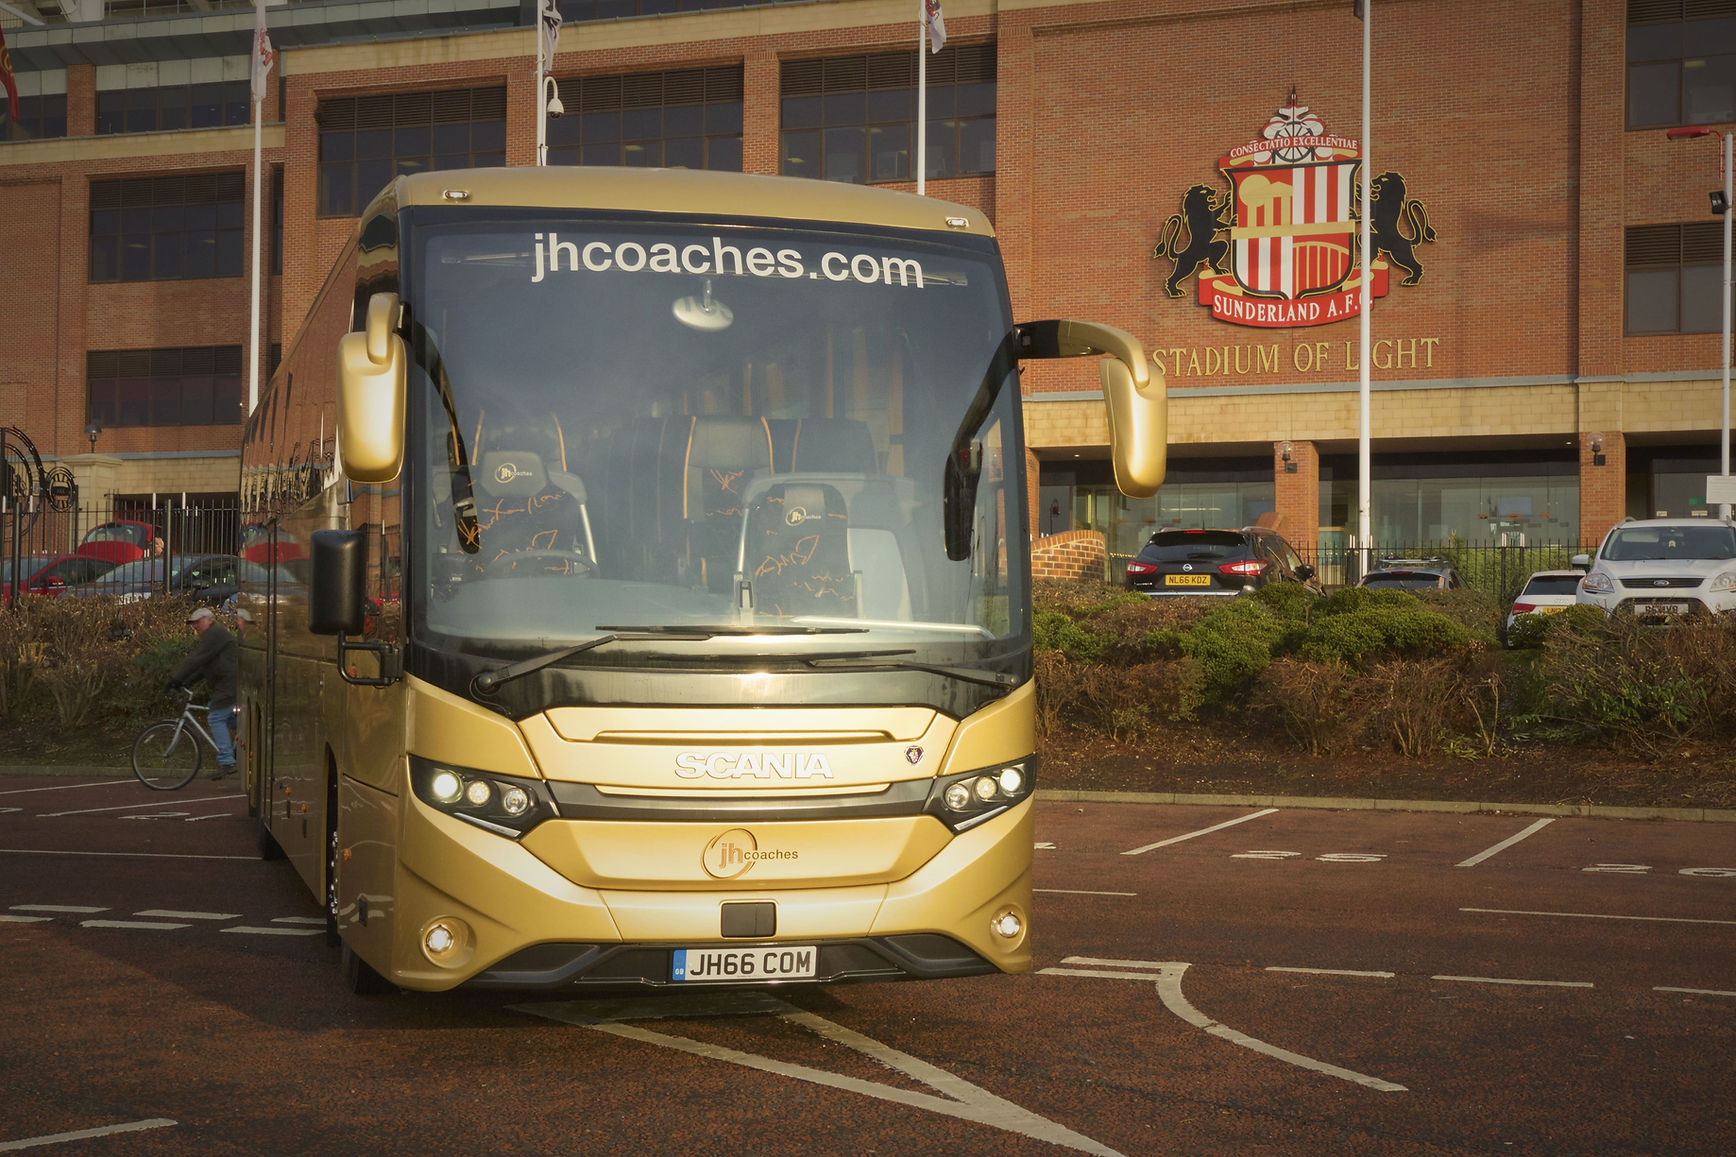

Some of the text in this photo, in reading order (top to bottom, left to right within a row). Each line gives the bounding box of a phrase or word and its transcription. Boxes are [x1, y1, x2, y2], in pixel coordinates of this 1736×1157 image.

[1230, 136, 1358, 158] CONSECTATIO EXCELLENTIAE
[531, 232, 924, 289] jhcoaches.com
[1214, 294, 1320, 322] SUNDERLAND
[1152, 337, 1440, 377] STADIUM OF LGHT
[675, 752, 834, 779] SCANIA
[719, 842, 799, 869] jh coaches
[690, 951, 811, 976] JH66 COM
